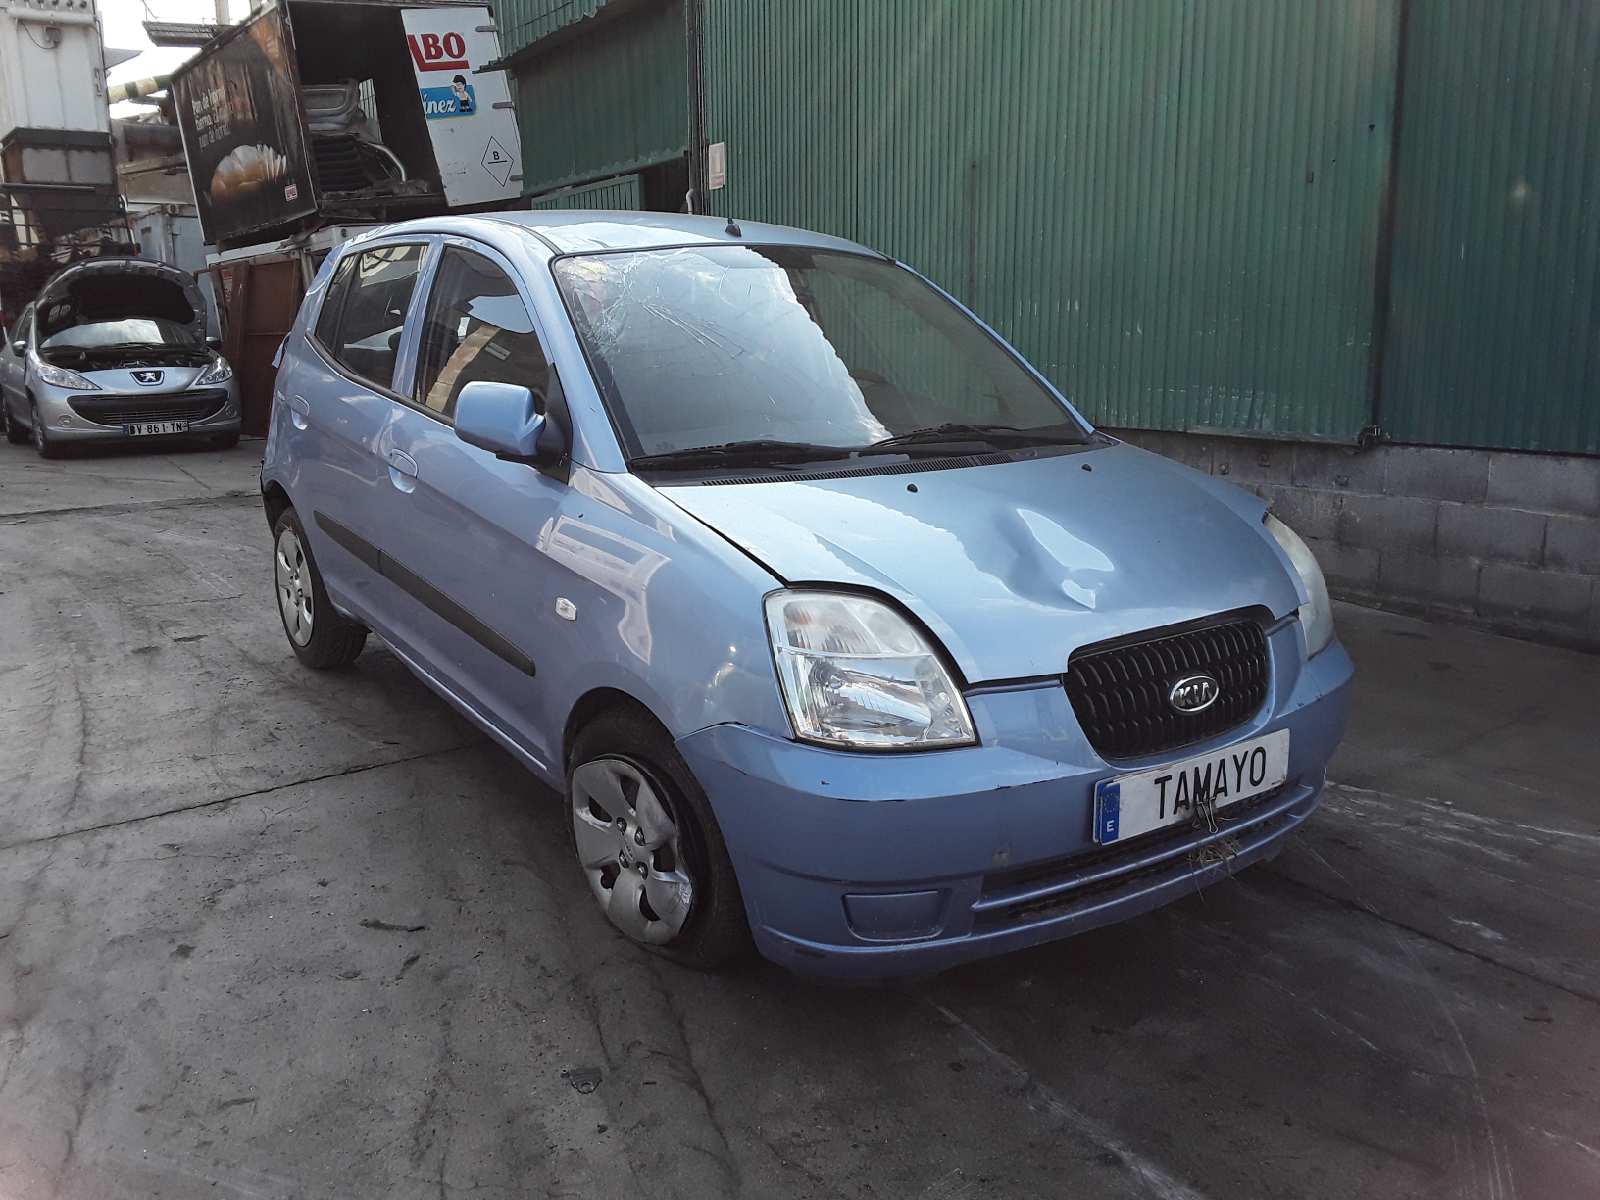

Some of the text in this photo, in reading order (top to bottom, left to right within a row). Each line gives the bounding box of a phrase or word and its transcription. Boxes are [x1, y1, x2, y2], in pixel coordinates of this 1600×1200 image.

[407, 32, 467, 61] BO
[492, 151, 500, 160] B
[1175, 681, 1213, 706] KIA
[1154, 746, 1267, 820] TAMAYO
[1106, 820, 1115, 832] E
